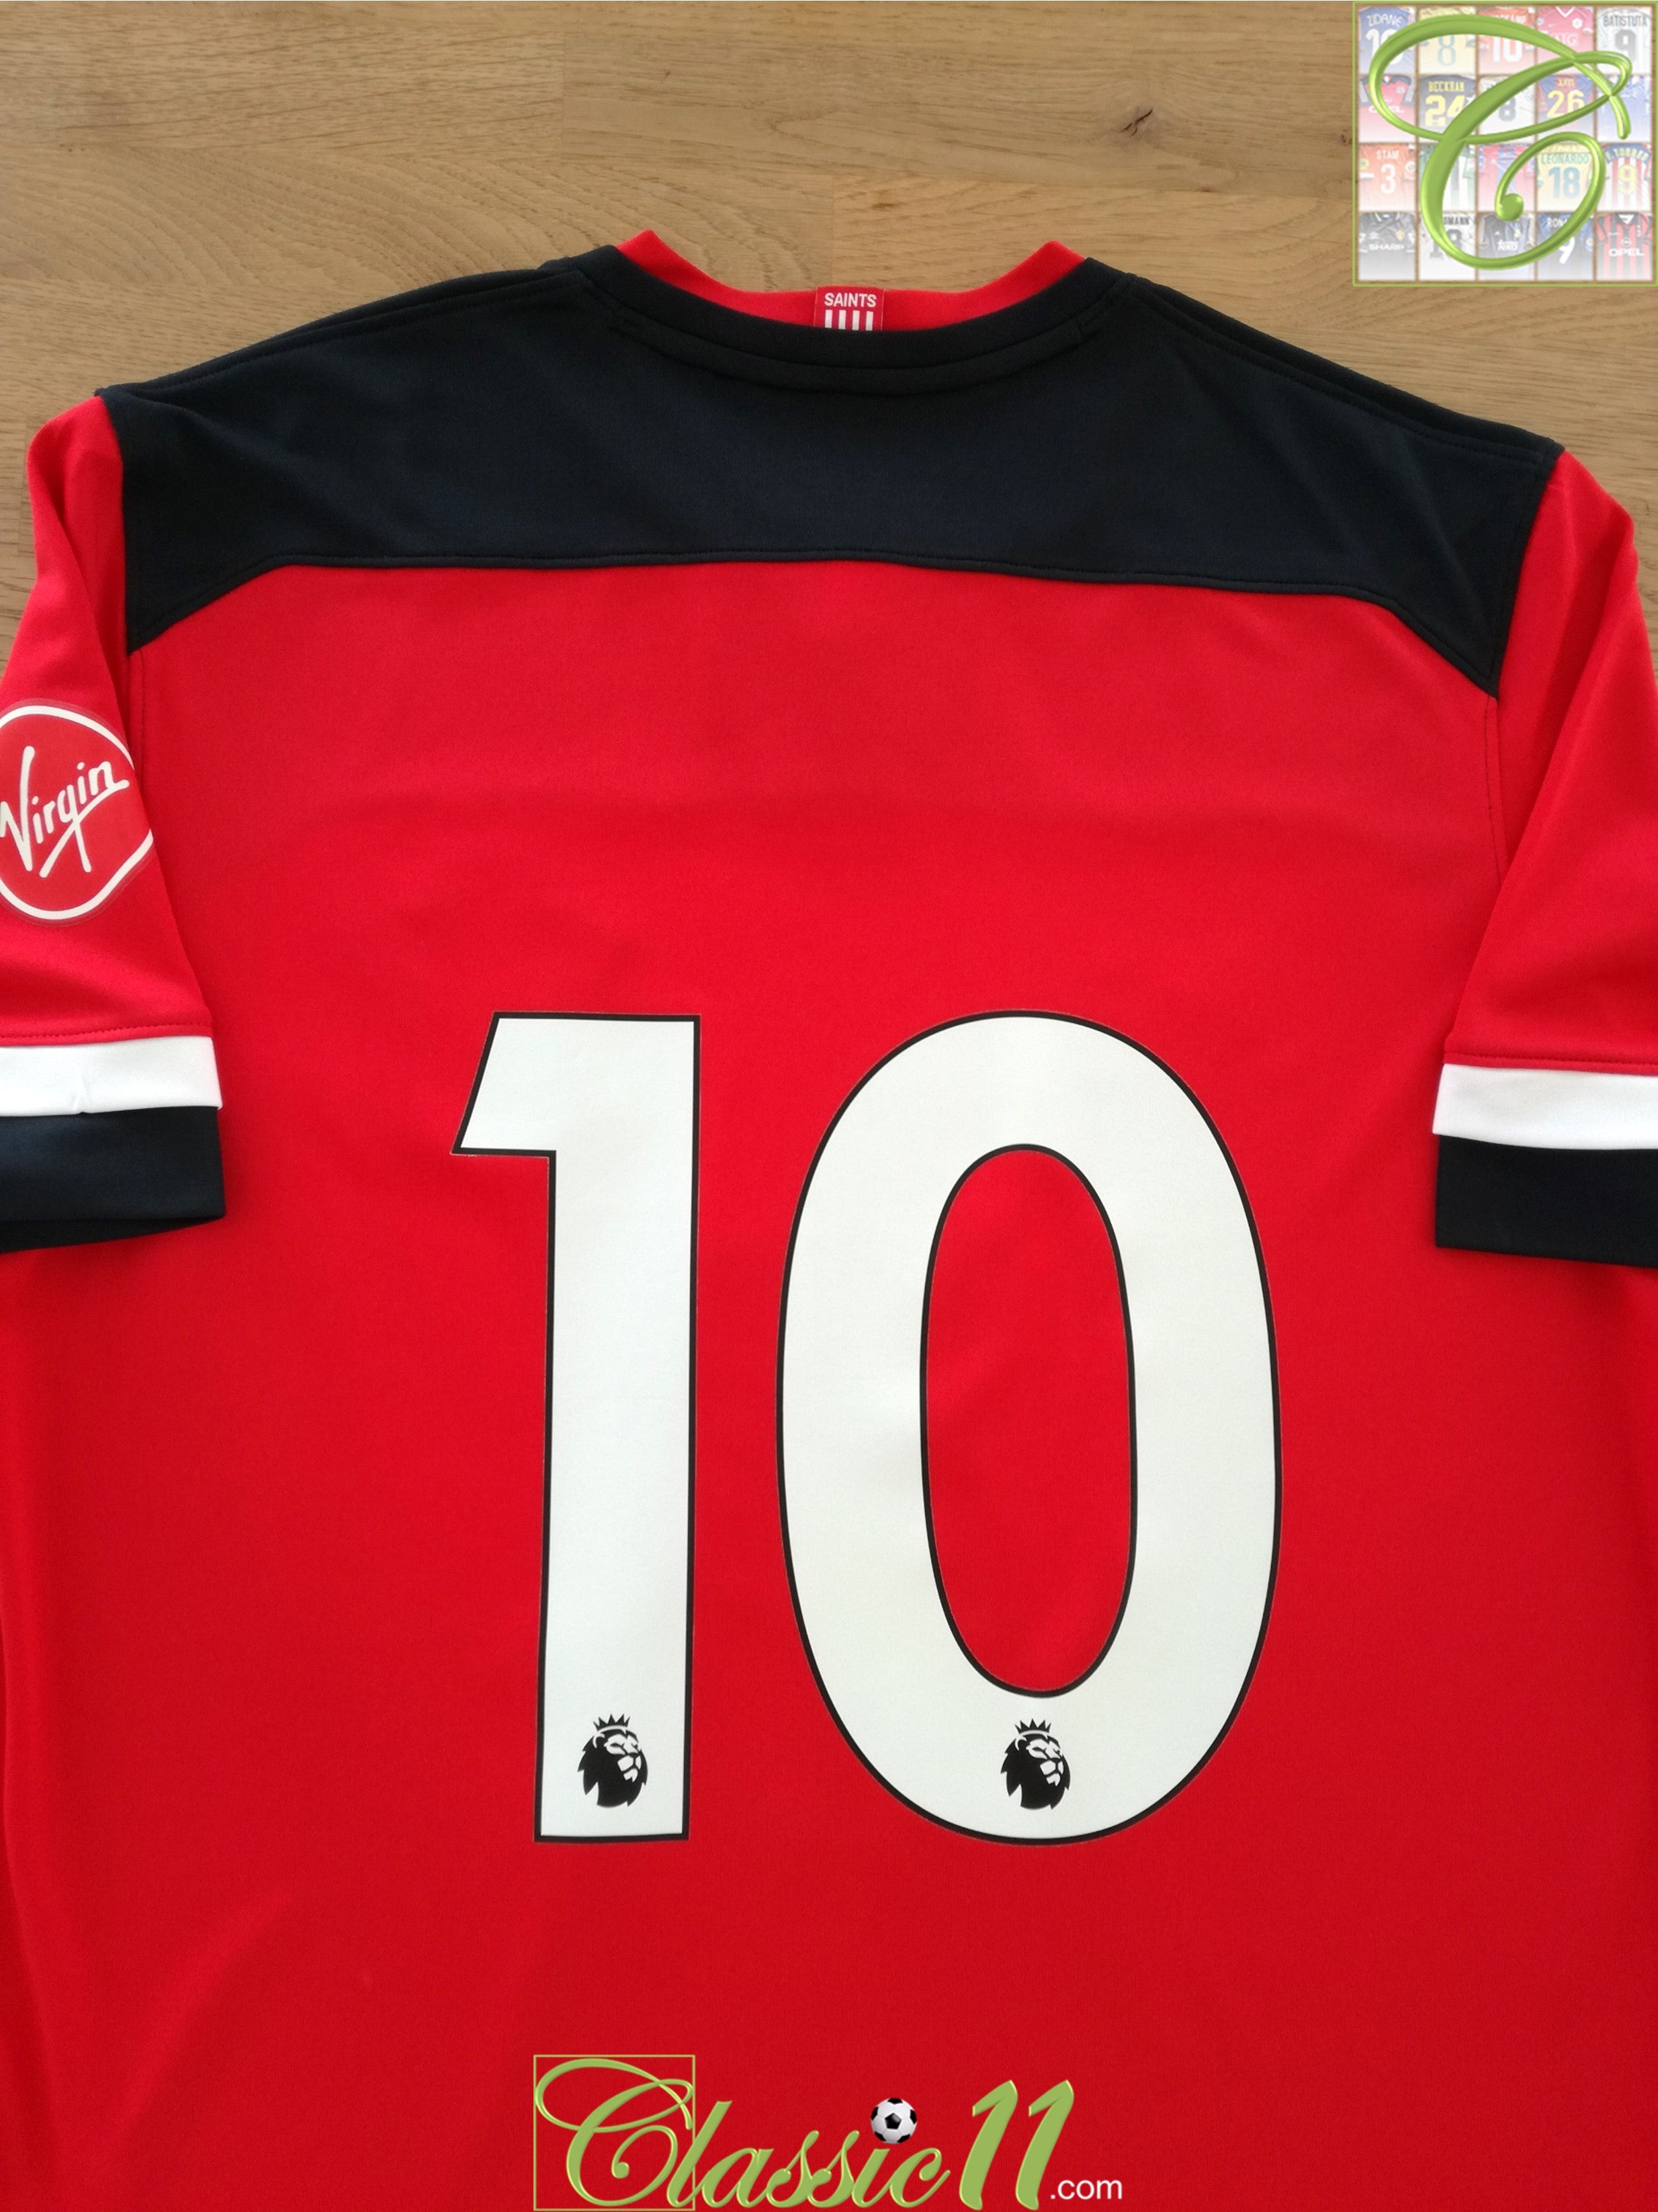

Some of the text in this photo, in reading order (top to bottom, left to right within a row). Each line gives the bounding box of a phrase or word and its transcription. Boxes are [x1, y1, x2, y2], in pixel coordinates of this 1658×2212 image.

[824, 292, 877, 308] SAINTS
[0, 746, 130, 877] Virgin
[452, 1010, 1283, 1845] 10
